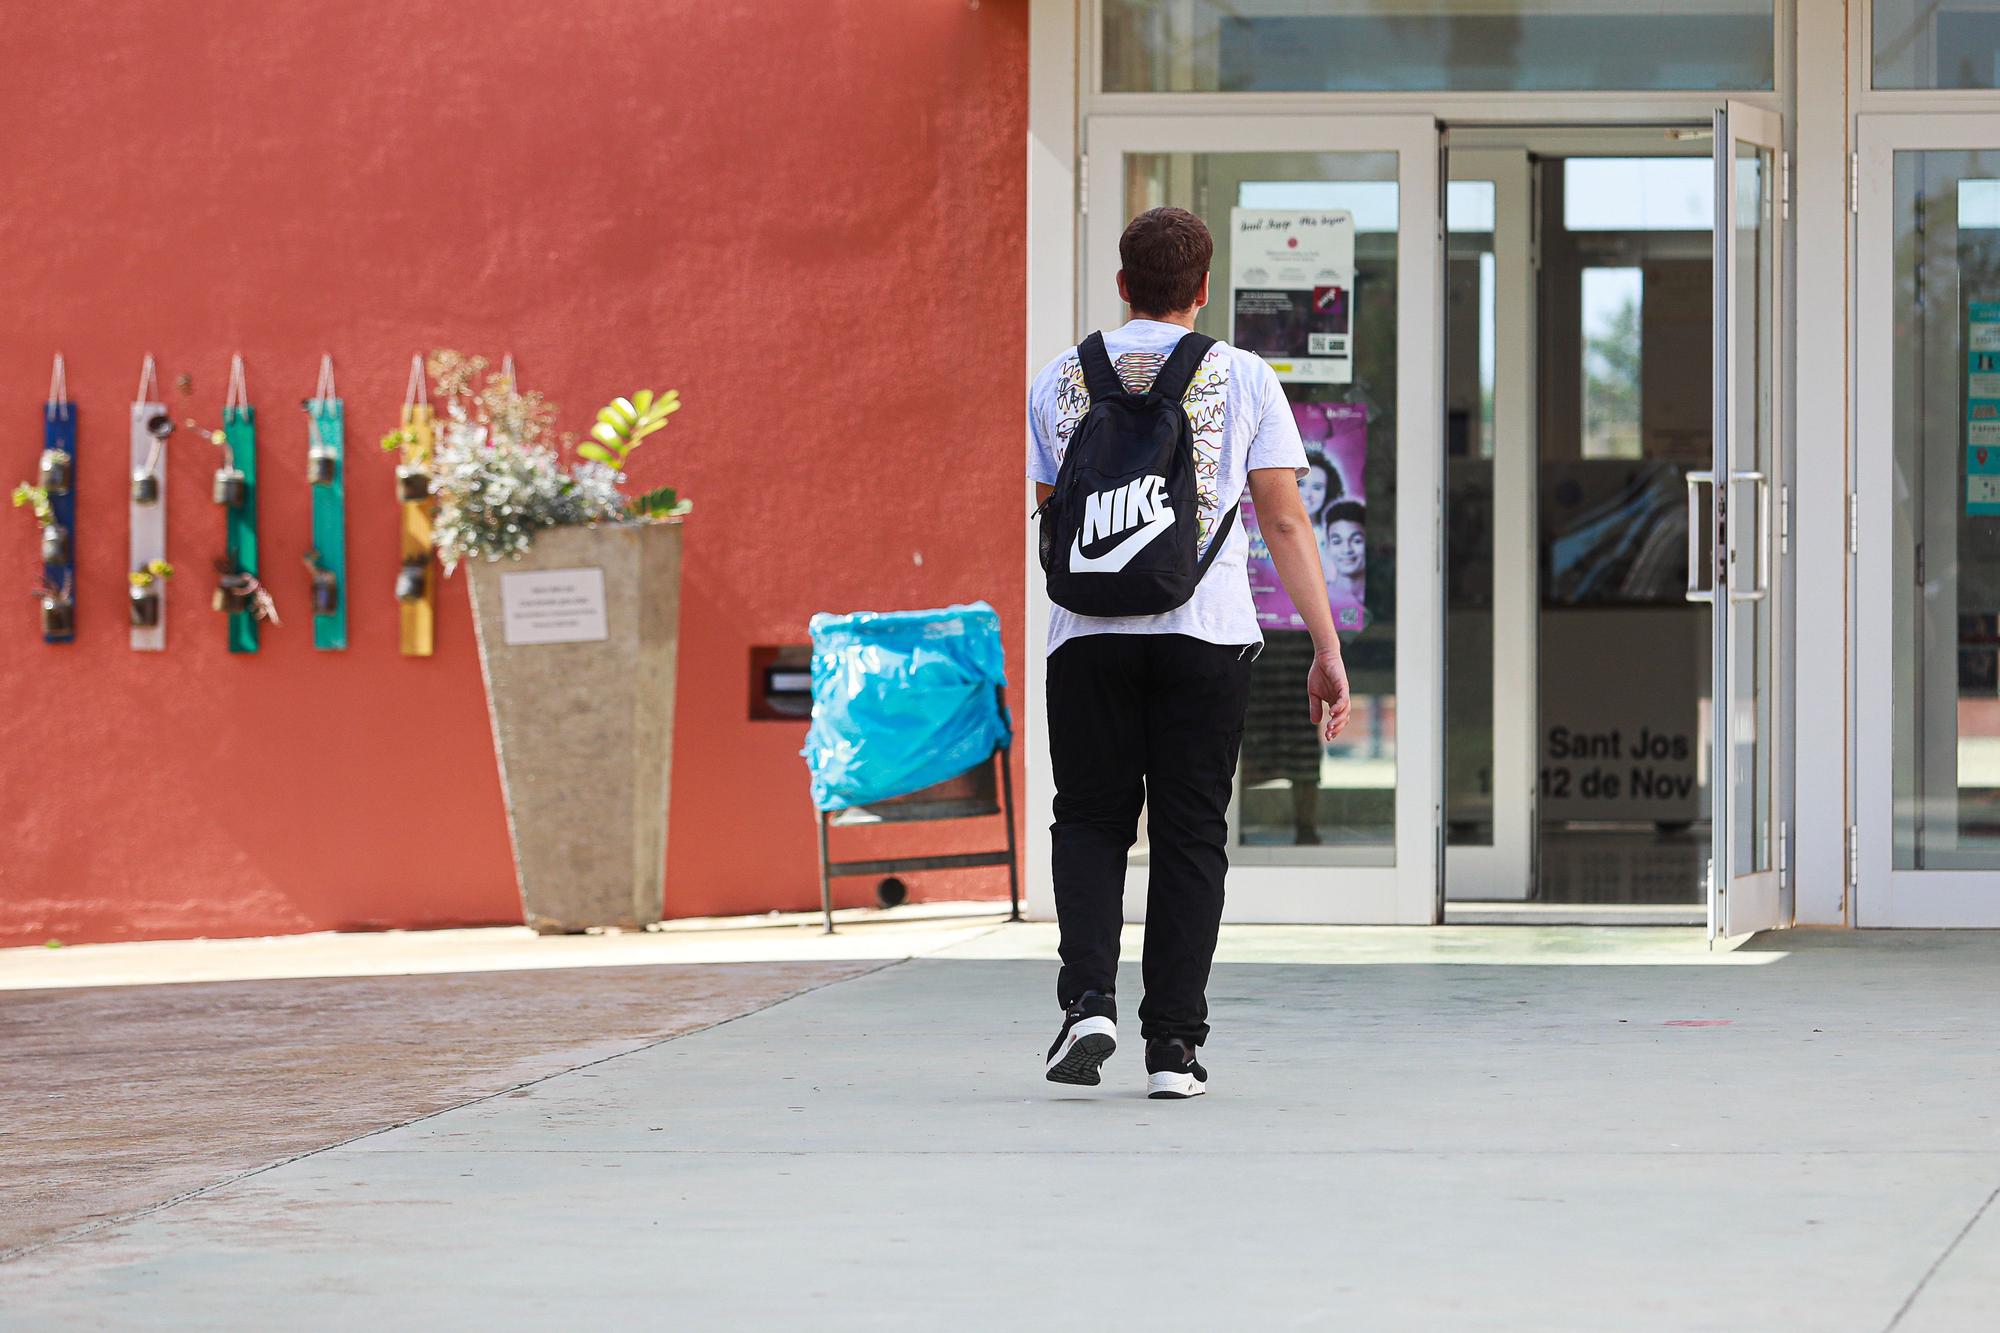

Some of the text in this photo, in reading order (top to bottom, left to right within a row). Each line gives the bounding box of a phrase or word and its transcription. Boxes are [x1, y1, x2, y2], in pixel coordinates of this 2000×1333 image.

[1082, 475, 1174, 548] NIKE
[1549, 725, 1621, 759] Sant
[1580, 769, 1622, 798] de
